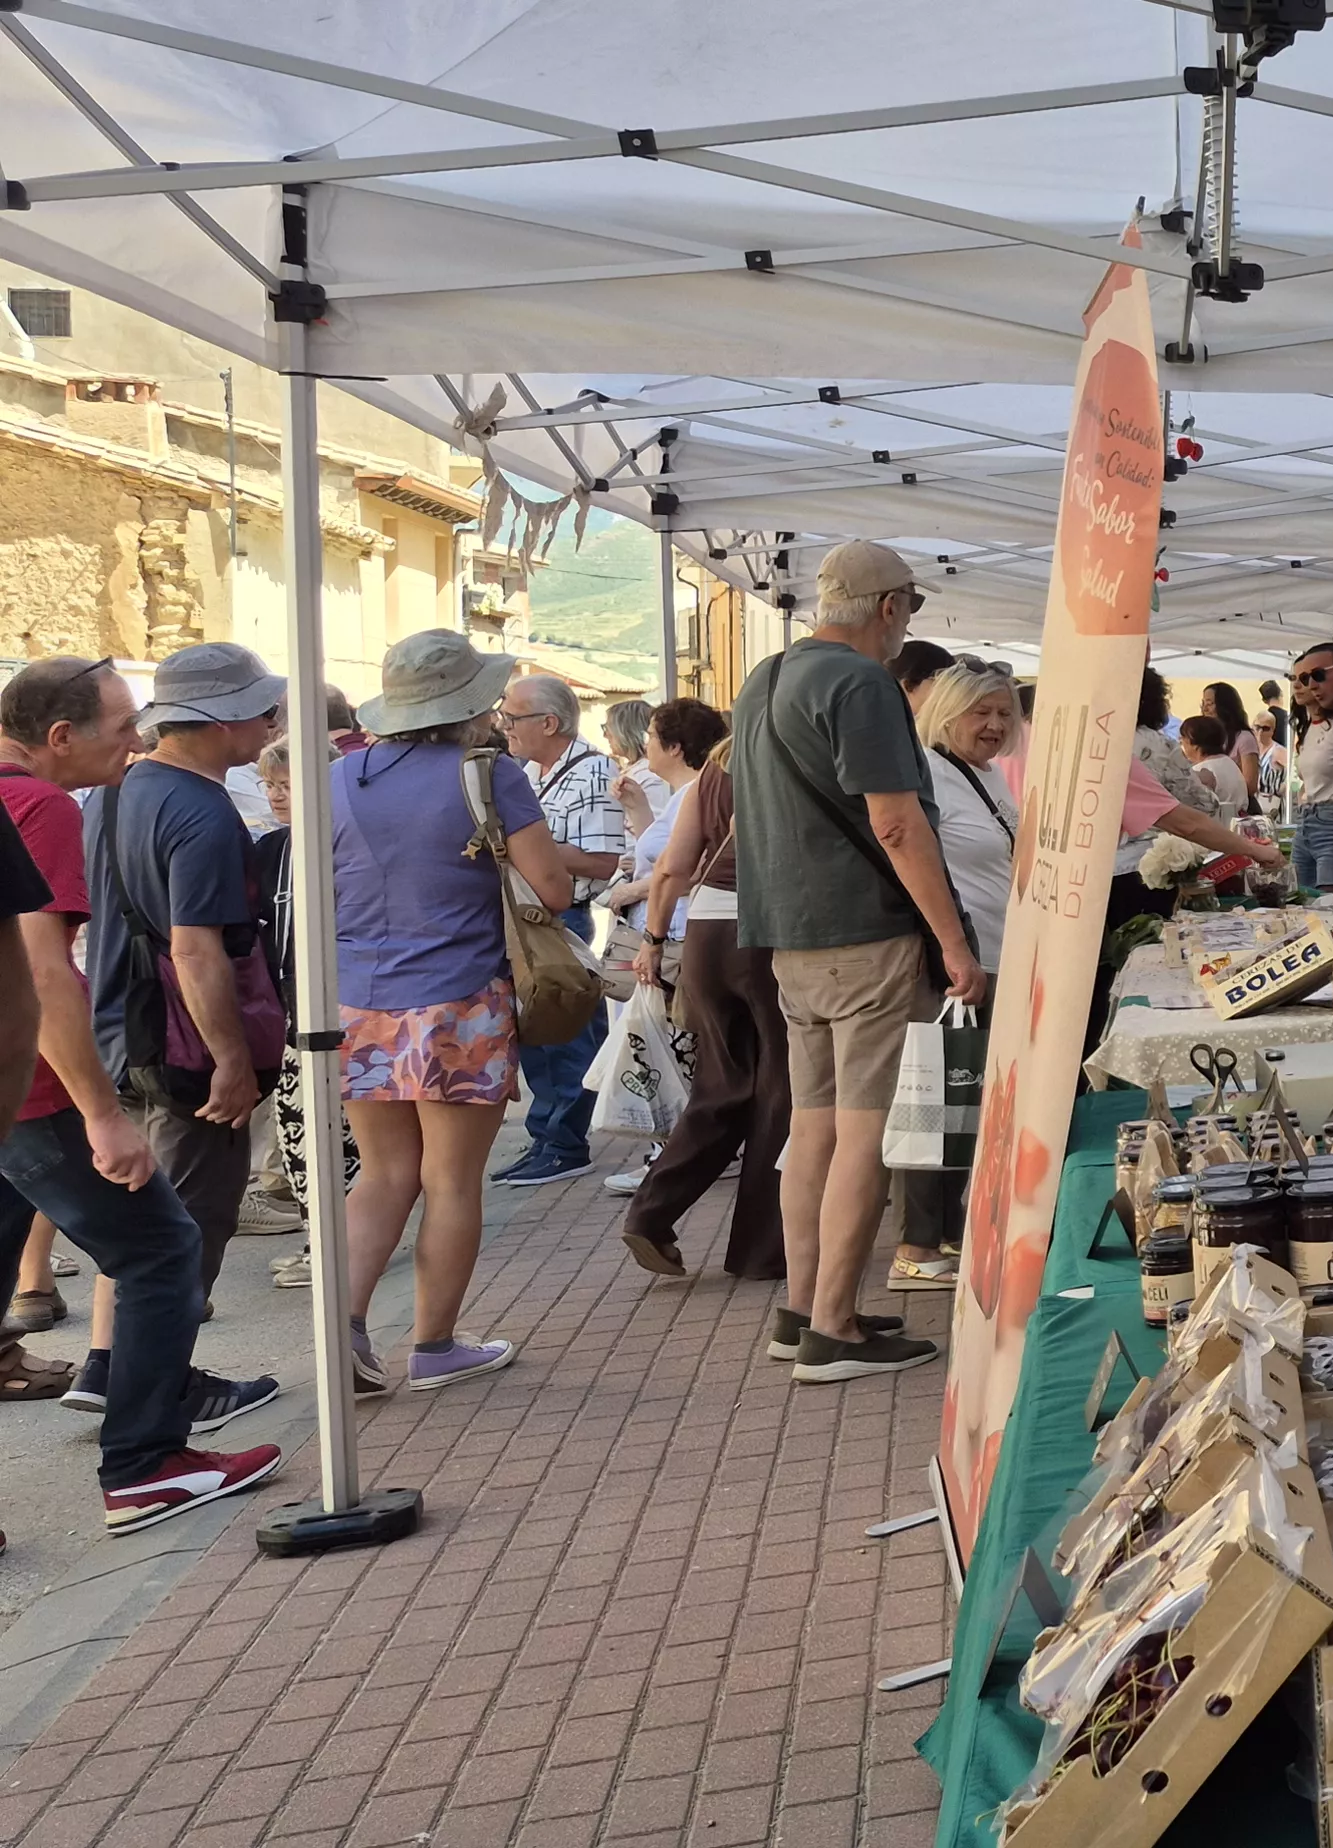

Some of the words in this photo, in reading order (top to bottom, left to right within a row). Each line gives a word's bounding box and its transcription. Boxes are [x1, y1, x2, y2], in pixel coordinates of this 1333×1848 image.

[1106, 451, 1155, 488] Calidad:
[1087, 480, 1137, 544] Sabor
[1075, 709, 1116, 849] BOLEA
[1063, 863, 1088, 919] DE
[1225, 942, 1322, 1005] BOLEA
[1232, 951, 1284, 985] CEREZAS
[1286, 942, 1304, 954] DE
